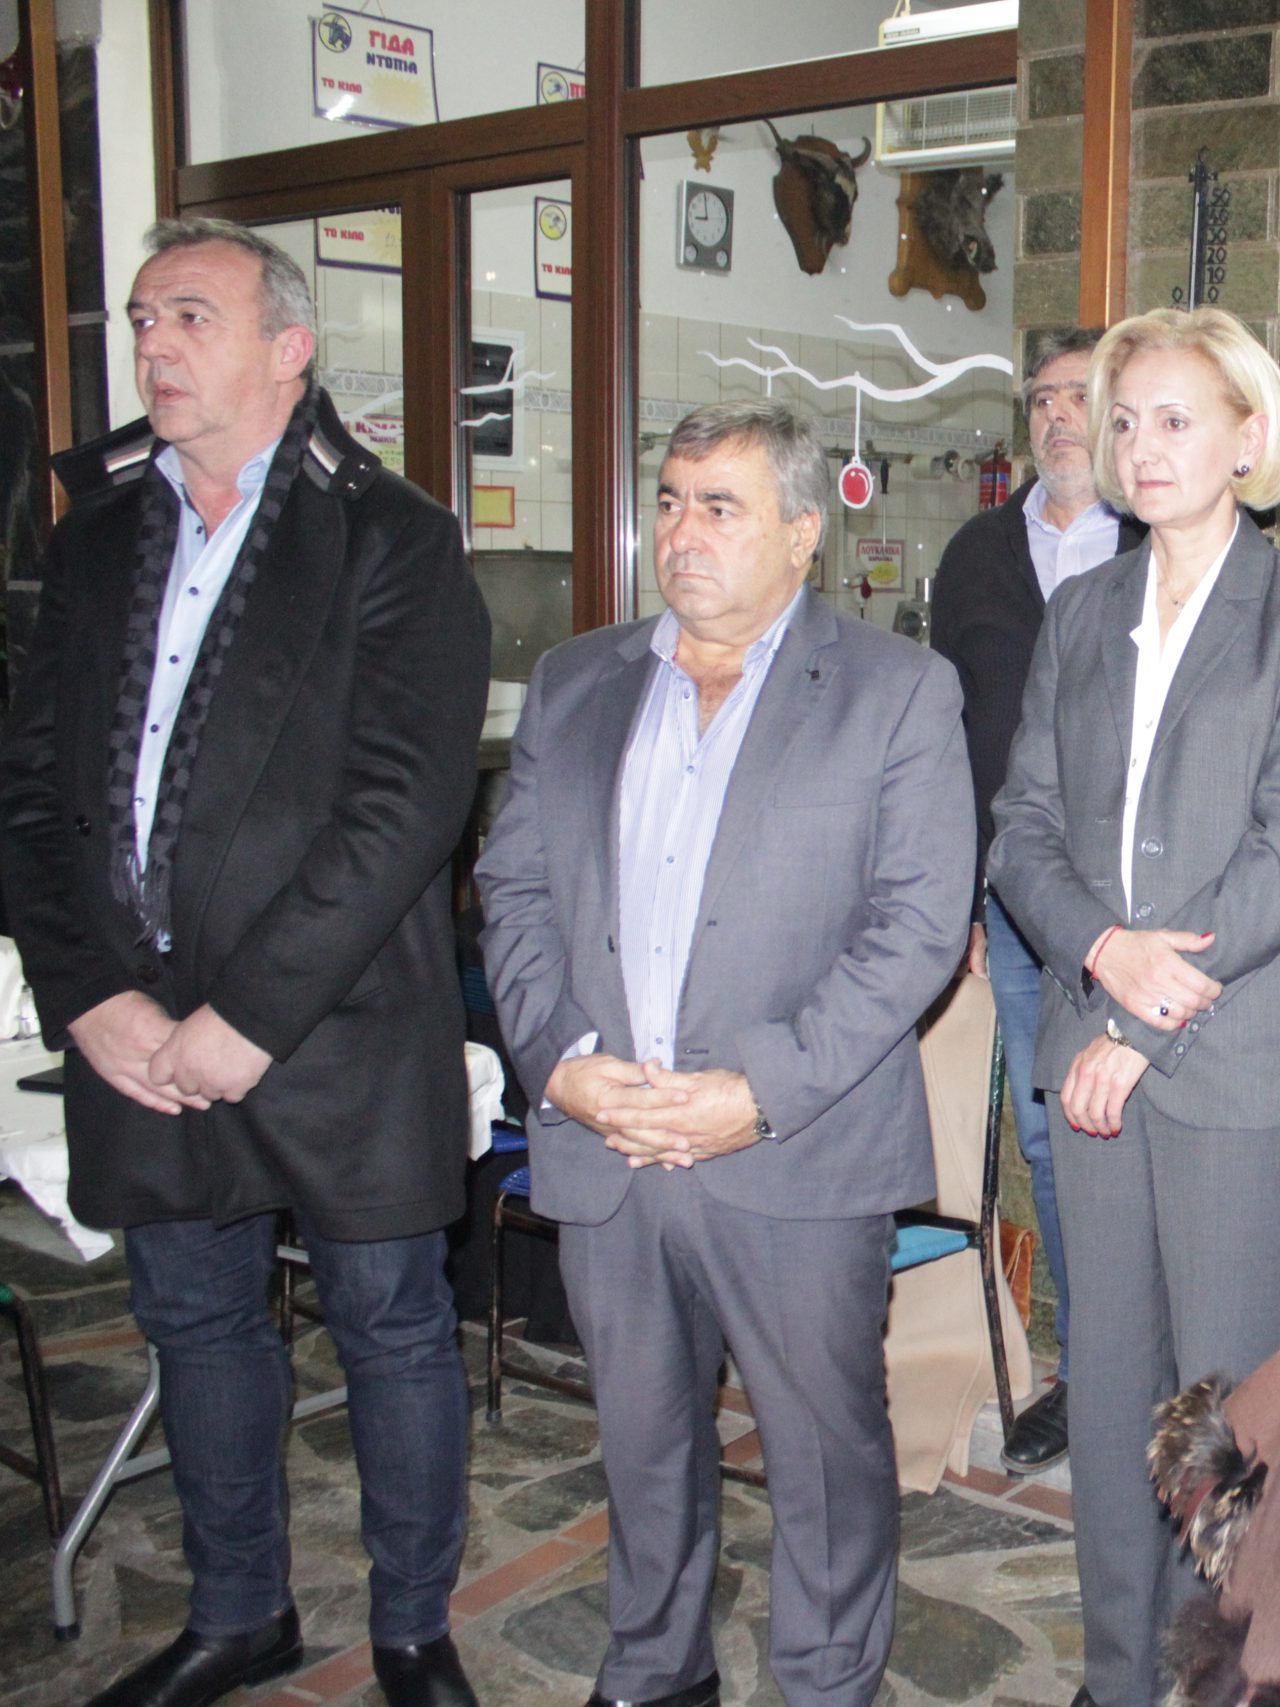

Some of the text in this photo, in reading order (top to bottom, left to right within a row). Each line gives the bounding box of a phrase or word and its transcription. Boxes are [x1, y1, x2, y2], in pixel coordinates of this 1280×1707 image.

[369, 30, 415, 56] ΓΙΔΑ
[366, 52, 418, 75] ΝΤΟΠΙΑ
[321, 77, 362, 94] ΤΟ ΚΙΛΟ
[323, 227, 364, 241] ΤΟ ΚΙΛΟ
[1207, 245, 1227, 265] 20
[1206, 265, 1226, 284] 10
[861, 546, 900, 556] ΛΟΥΚΑΝΙΚΑ
